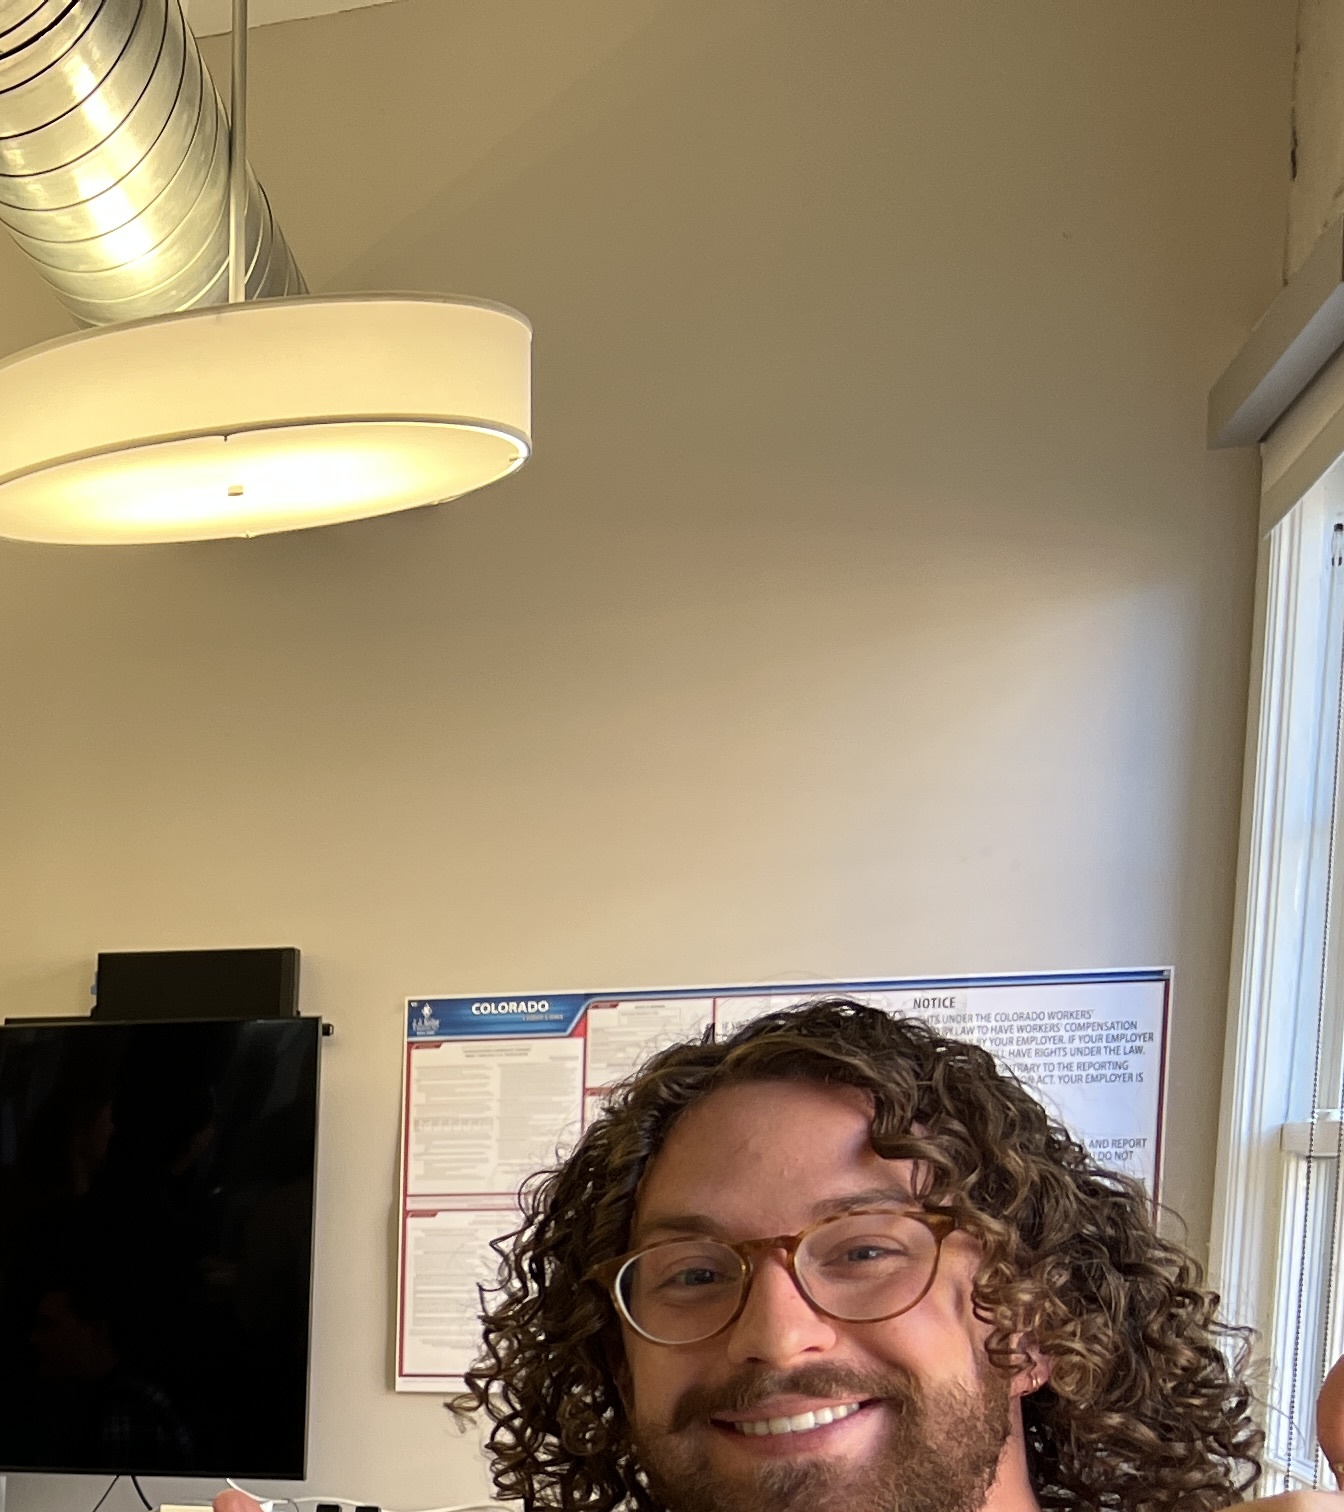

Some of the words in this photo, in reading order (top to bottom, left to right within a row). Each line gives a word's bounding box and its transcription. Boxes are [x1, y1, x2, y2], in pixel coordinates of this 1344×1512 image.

[471, 1000, 549, 1015] COLORADO
[913, 997, 956, 1010] NOTICE
[942, 1013, 973, 1025] UNDER
[976, 1012, 992, 1023] THE
[994, 1010, 1045, 1022] COLORADO
[955, 1026, 975, 1036] LAW
[977, 1025, 989, 1035] TO
[991, 1024, 1014, 1035] HAVE
[1064, 1020, 1138, 1032] COMPENSATION
[989, 1036, 1014, 1047] YOUR
[1068, 1034, 1076, 1044] IF
[1078, 1034, 1103, 1044] YOUR
[1105, 1032, 1154, 1043] EMPLOYER
[1008, 1048, 1033, 1059] HAVE
[1034, 1047, 1067, 1058] RIGHTS
[1069, 1046, 1102, 1057] UNDER
[1103, 1045, 1122, 1056] THE
[1043, 1063, 1055, 1073] TO
[1057, 1062, 1075, 1072] THE
[1077, 1060, 1129, 1072] REPORTING
[1057, 1074, 1083, 1084] YOUR
[1085, 1073, 1133, 1084] EMPLOYER
[1135, 1072, 1144, 1083] IS
[1088, 1138, 1110, 1149] AND
[1111, 1138, 1148, 1149] REPORT
[1097, 1151, 1113, 1161] DO
[1114, 1150, 1134, 1161] NOT
